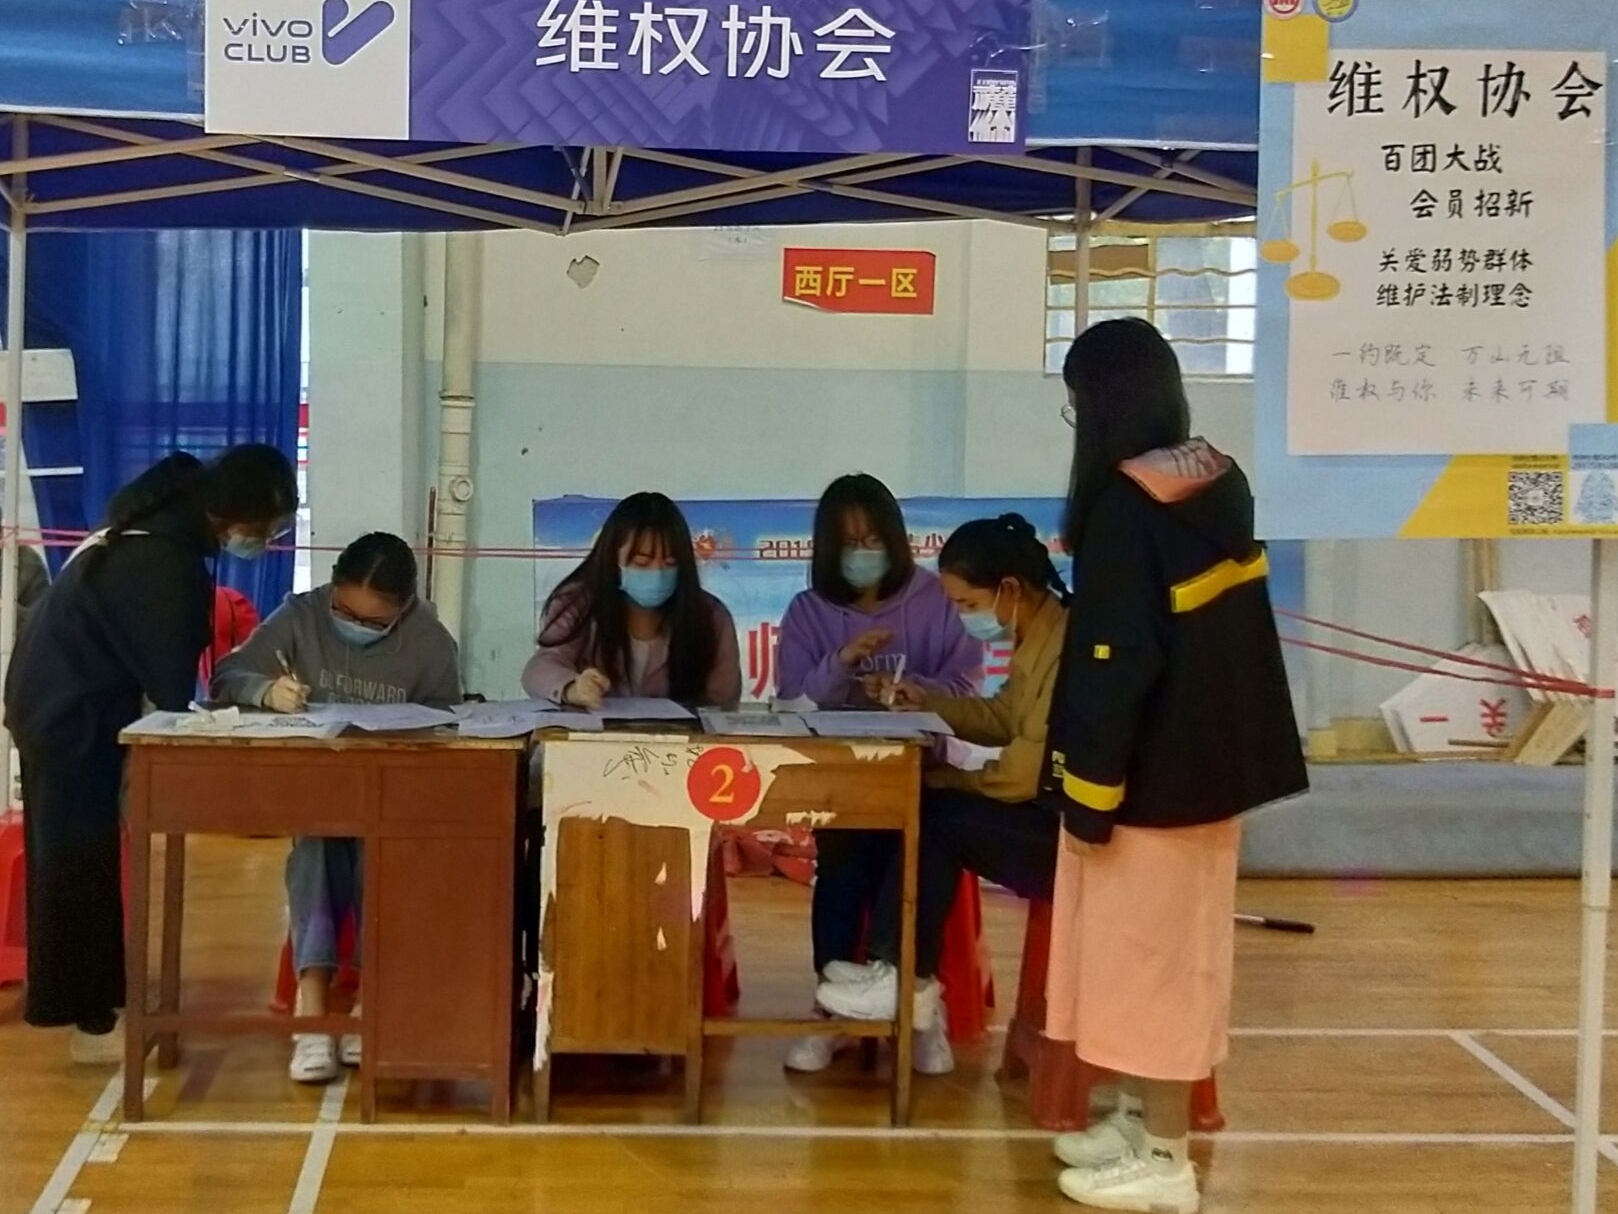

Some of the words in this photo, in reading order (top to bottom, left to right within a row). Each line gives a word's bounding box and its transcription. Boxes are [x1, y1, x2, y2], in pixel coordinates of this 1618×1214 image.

[222, 12, 314, 38] vivo
[535, 0, 896, 82] 维权协会
[223, 43, 312, 64] CLUB
[1327, 59, 1604, 121] 维权协会
[1380, 143, 1504, 175] 百团大战
[1409, 188, 1535, 220] 会员招新
[1378, 247, 1535, 274] 关爱弱势群体
[794, 265, 918, 298] 西厅一区
[1376, 282, 1534, 309] 维护法制理念
[708, 763, 736, 804] 2
